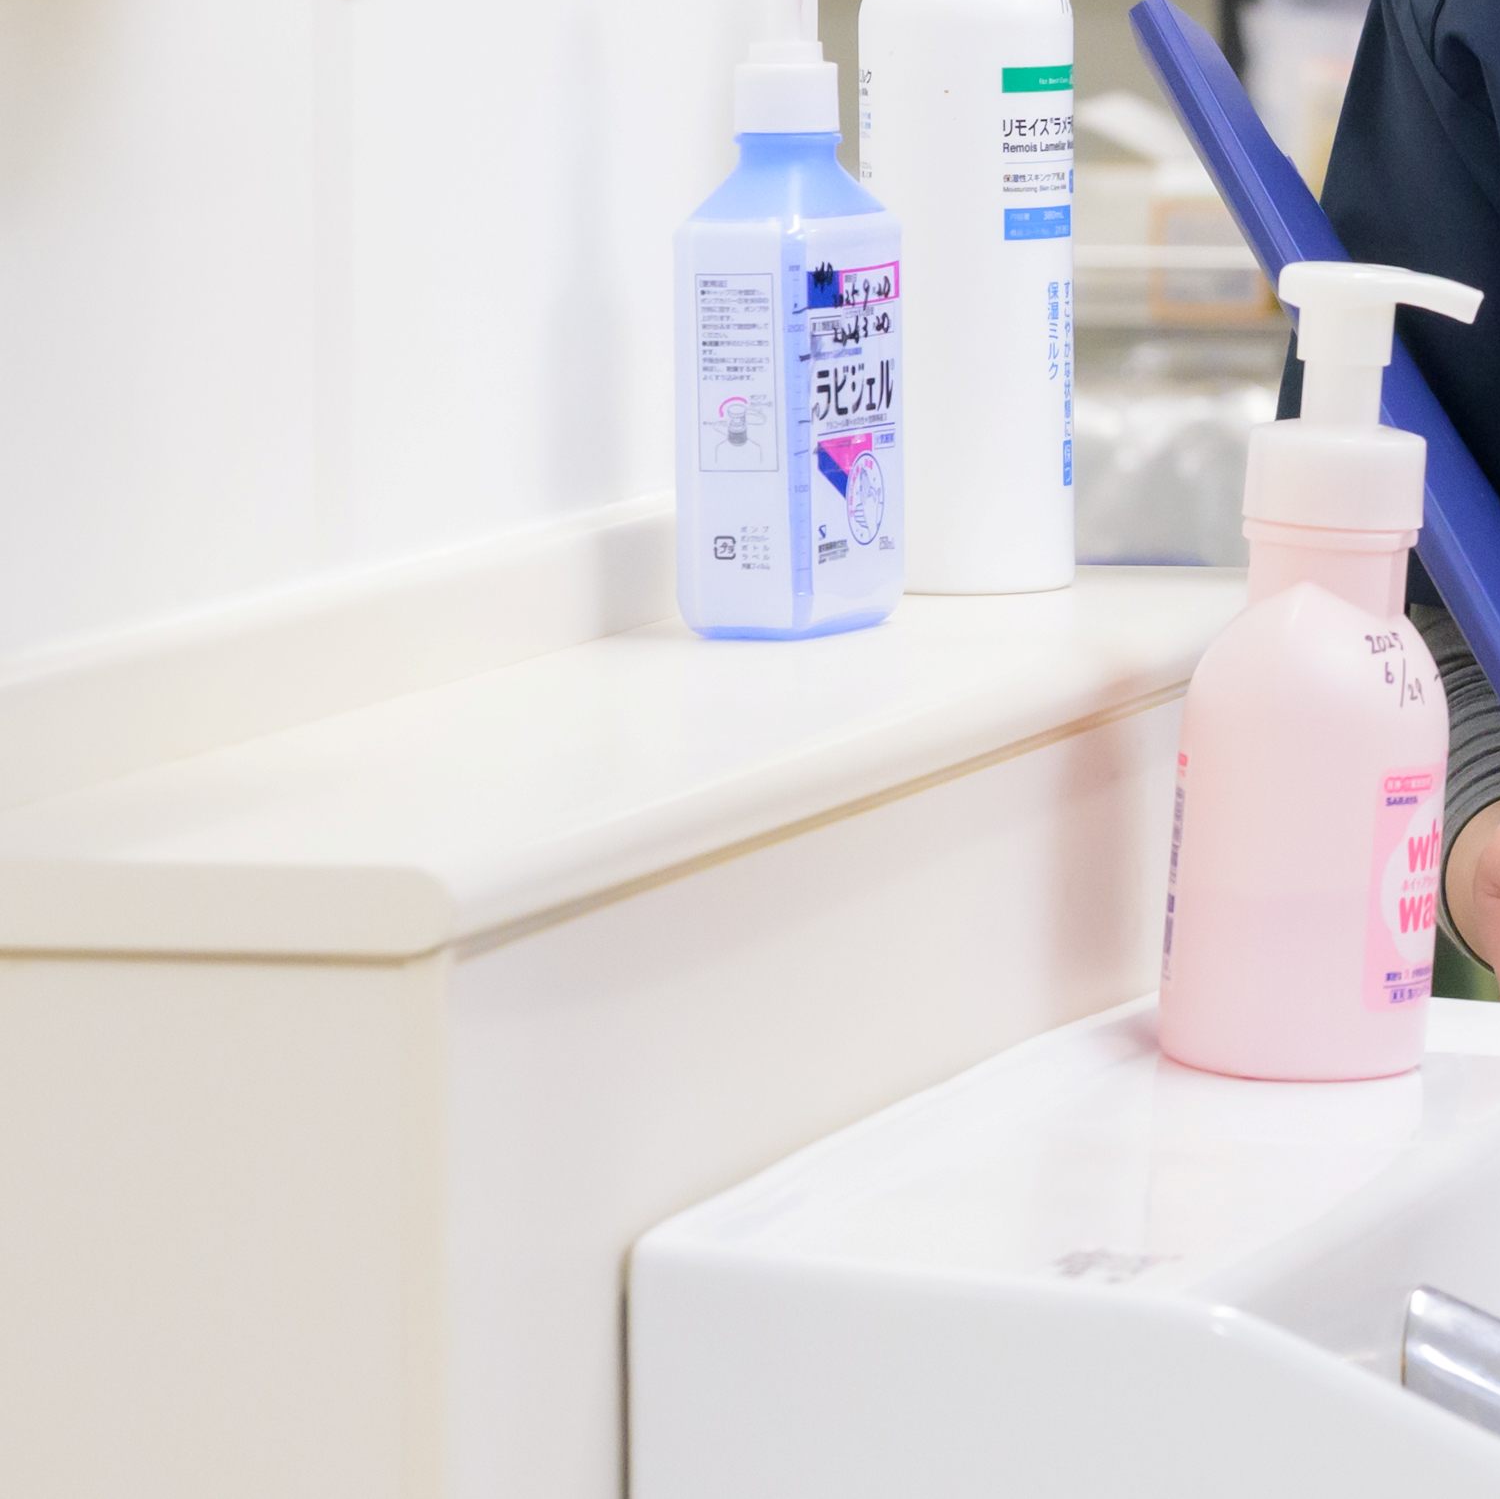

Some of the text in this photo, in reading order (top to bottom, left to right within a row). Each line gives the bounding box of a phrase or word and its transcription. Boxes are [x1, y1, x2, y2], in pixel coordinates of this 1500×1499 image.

[1003, 142, 1038, 153] Remois
[816, 359, 895, 421] ラビジェル
